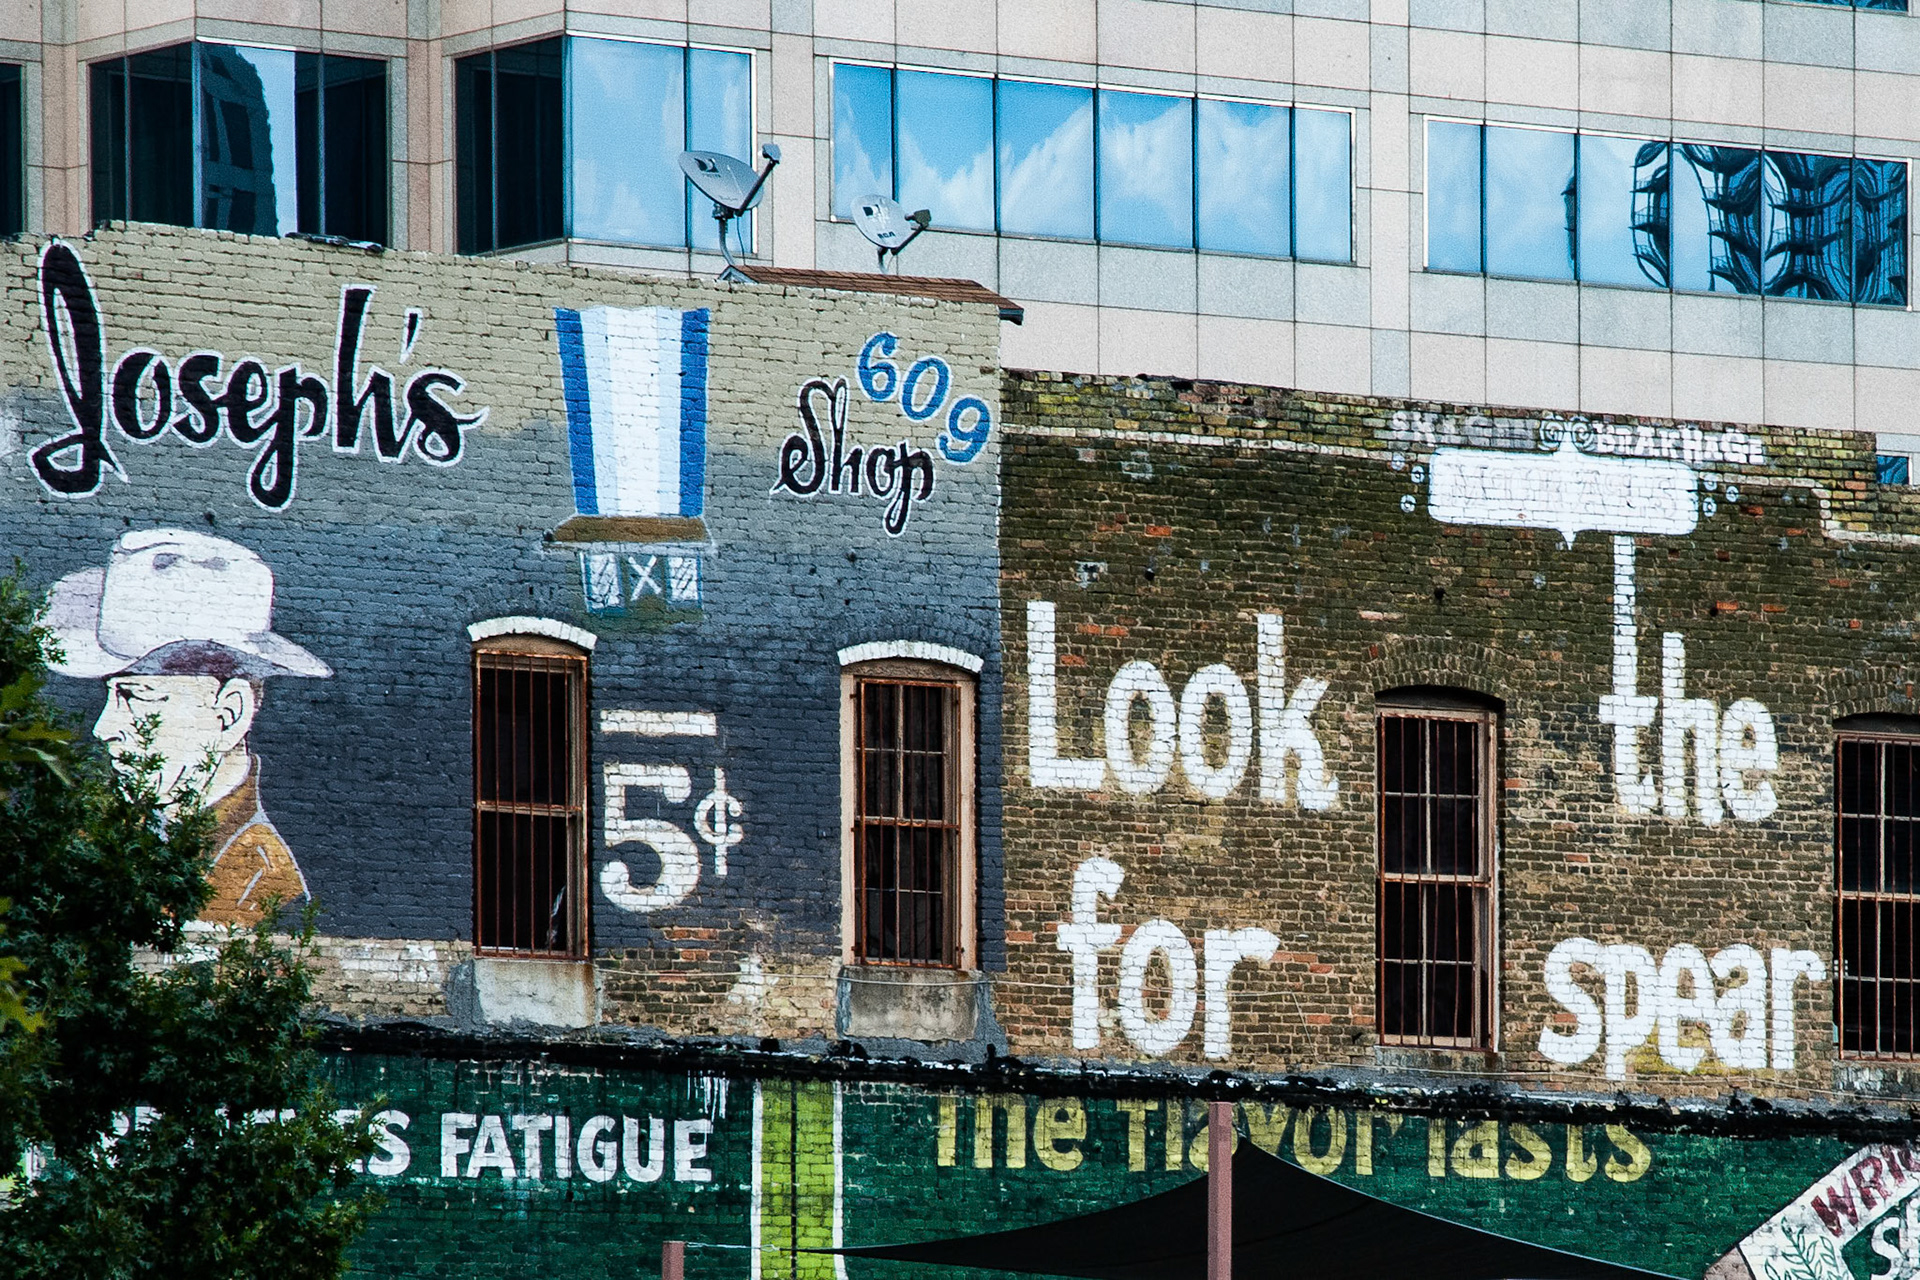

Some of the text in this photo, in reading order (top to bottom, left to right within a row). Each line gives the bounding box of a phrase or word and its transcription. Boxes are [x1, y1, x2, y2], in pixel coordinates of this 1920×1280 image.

[27, 238, 489, 513] Joseph's
[769, 375, 937, 538] Shop
[856, 332, 992, 465] 609
[1027, 536, 1778, 826] Look the
[1057, 857, 1826, 1080] for spear
[440, 1112, 714, 1182] FATIGUE
